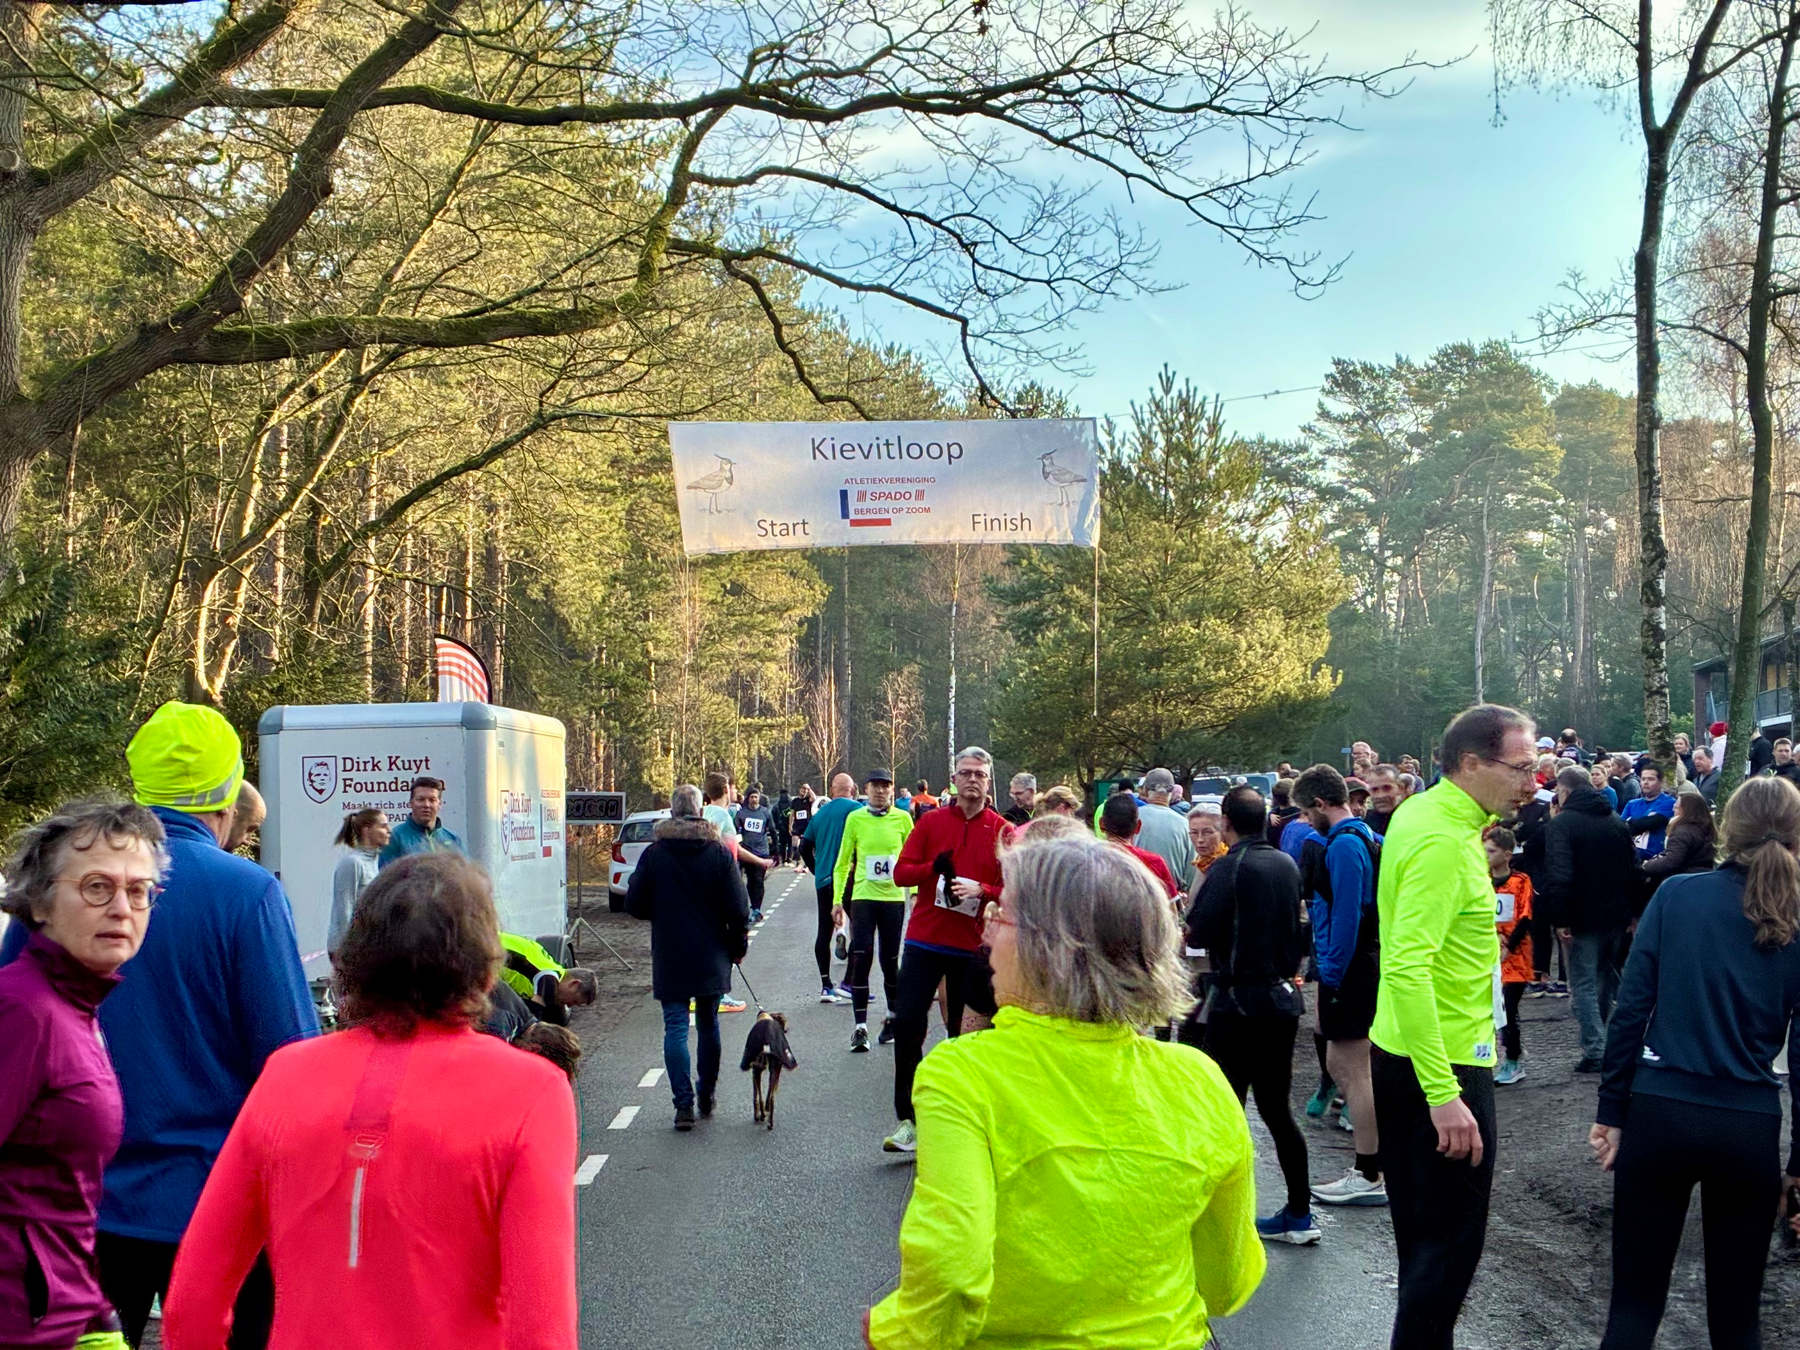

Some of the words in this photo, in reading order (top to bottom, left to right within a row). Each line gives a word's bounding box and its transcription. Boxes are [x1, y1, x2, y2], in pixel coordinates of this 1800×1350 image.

[811, 435, 964, 465] Kievitloop
[843, 476, 936, 485] ATLETIEKVERENIGING
[869, 490, 913, 502] SPADO
[854, 507, 890, 515] BERGEN
[891, 507, 904, 515] OP
[905, 506, 931, 514] ZOOM
[757, 518, 810, 537] Start
[971, 512, 1032, 532] Finish
[341, 756, 382, 772] Dirk
[387, 755, 431, 775] Kuyt
[374, 800, 395, 809] zich
[747, 820, 760, 830] 615
[874, 861, 890, 875] 64
